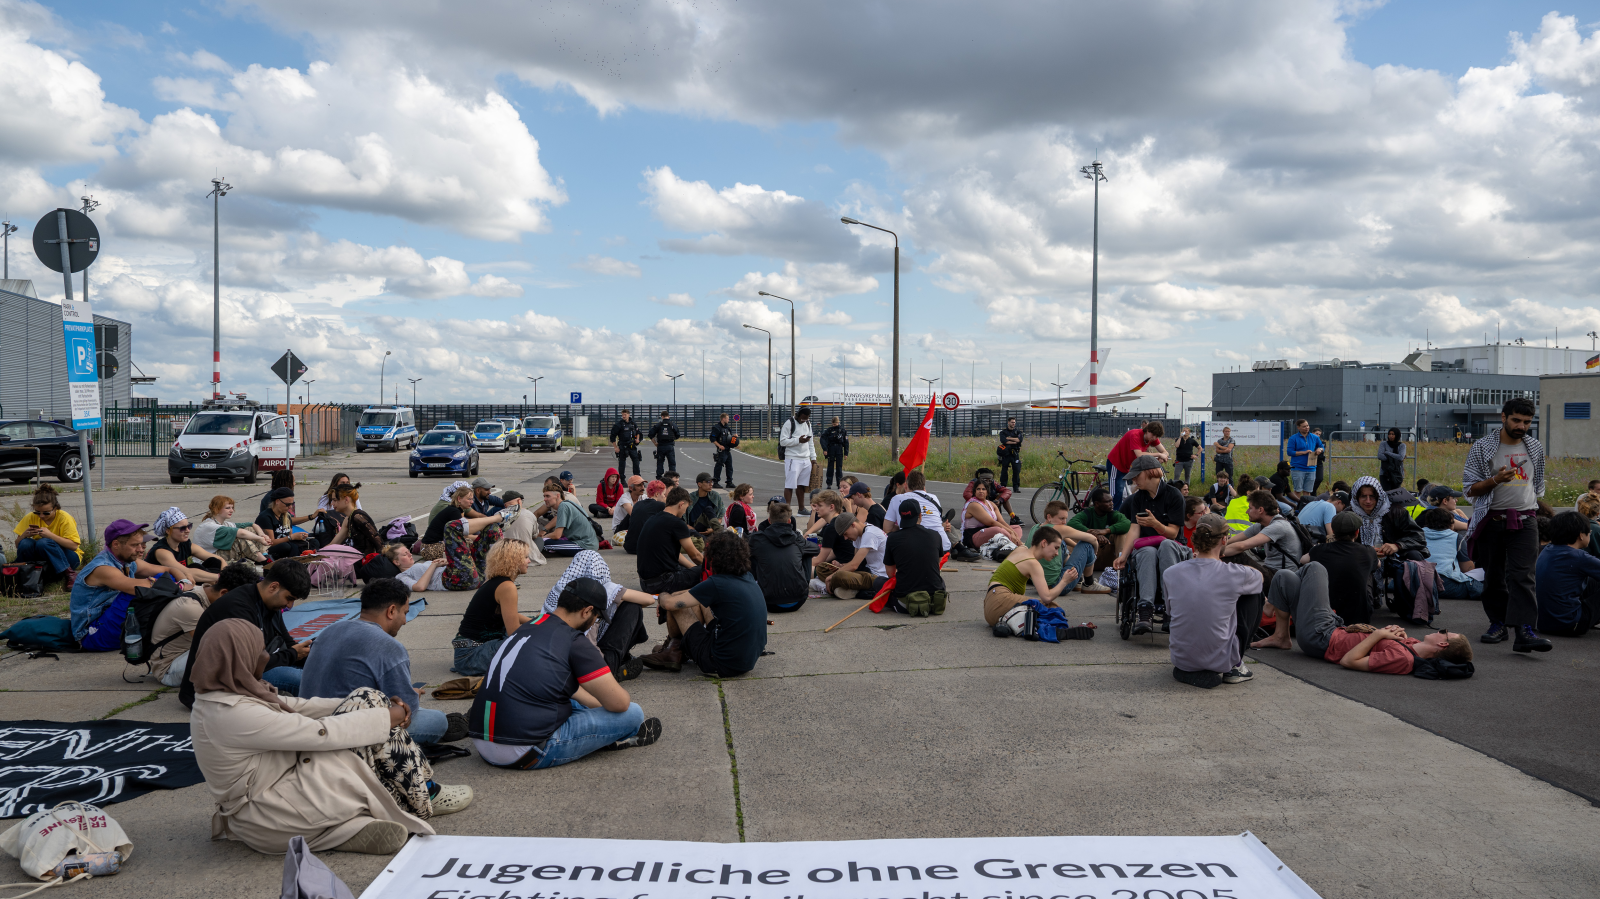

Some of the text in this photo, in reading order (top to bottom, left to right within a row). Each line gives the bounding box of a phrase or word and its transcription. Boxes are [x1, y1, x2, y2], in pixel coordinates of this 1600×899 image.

[77, 346, 86, 366] P
[572, 394, 579, 402] P
[946, 396, 957, 406] 30
[422, 858, 1238, 884] Jugendliche ohne Grenzen
